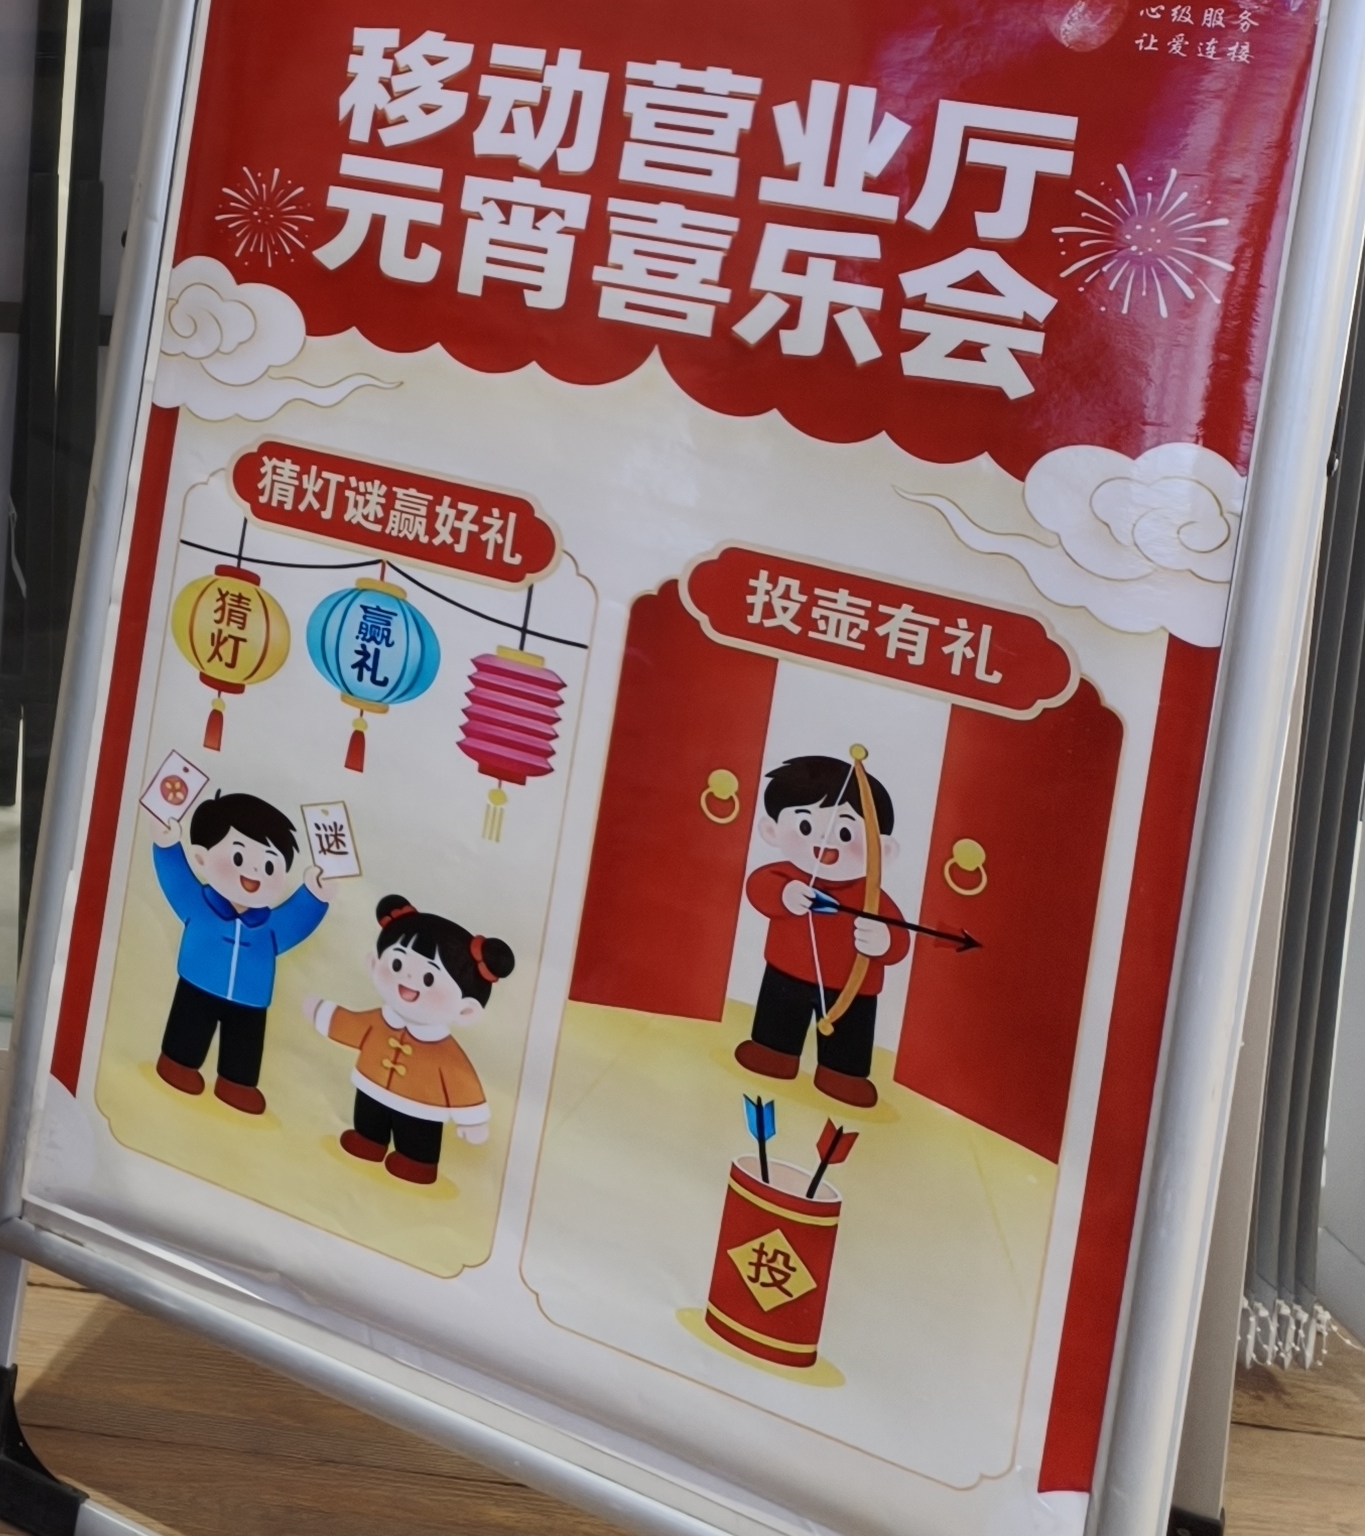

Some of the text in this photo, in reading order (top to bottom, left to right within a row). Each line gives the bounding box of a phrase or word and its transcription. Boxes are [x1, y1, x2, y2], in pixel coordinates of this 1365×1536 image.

[1134, 32, 1255, 65] 让爱连接
[1139, 4, 1259, 33] 心级服务
[338, 25, 1079, 244] 移动营业厅
[314, 152, 1060, 402] 元宵喜乐会
[255, 454, 528, 568] 猜灯谜赢好礼
[208, 587, 252, 671] 猜灯
[349, 605, 397, 691] 赢礼
[745, 571, 1006, 687] 投壶有礼
[312, 820, 350, 860] 谜
[748, 1239, 798, 1301] 投
